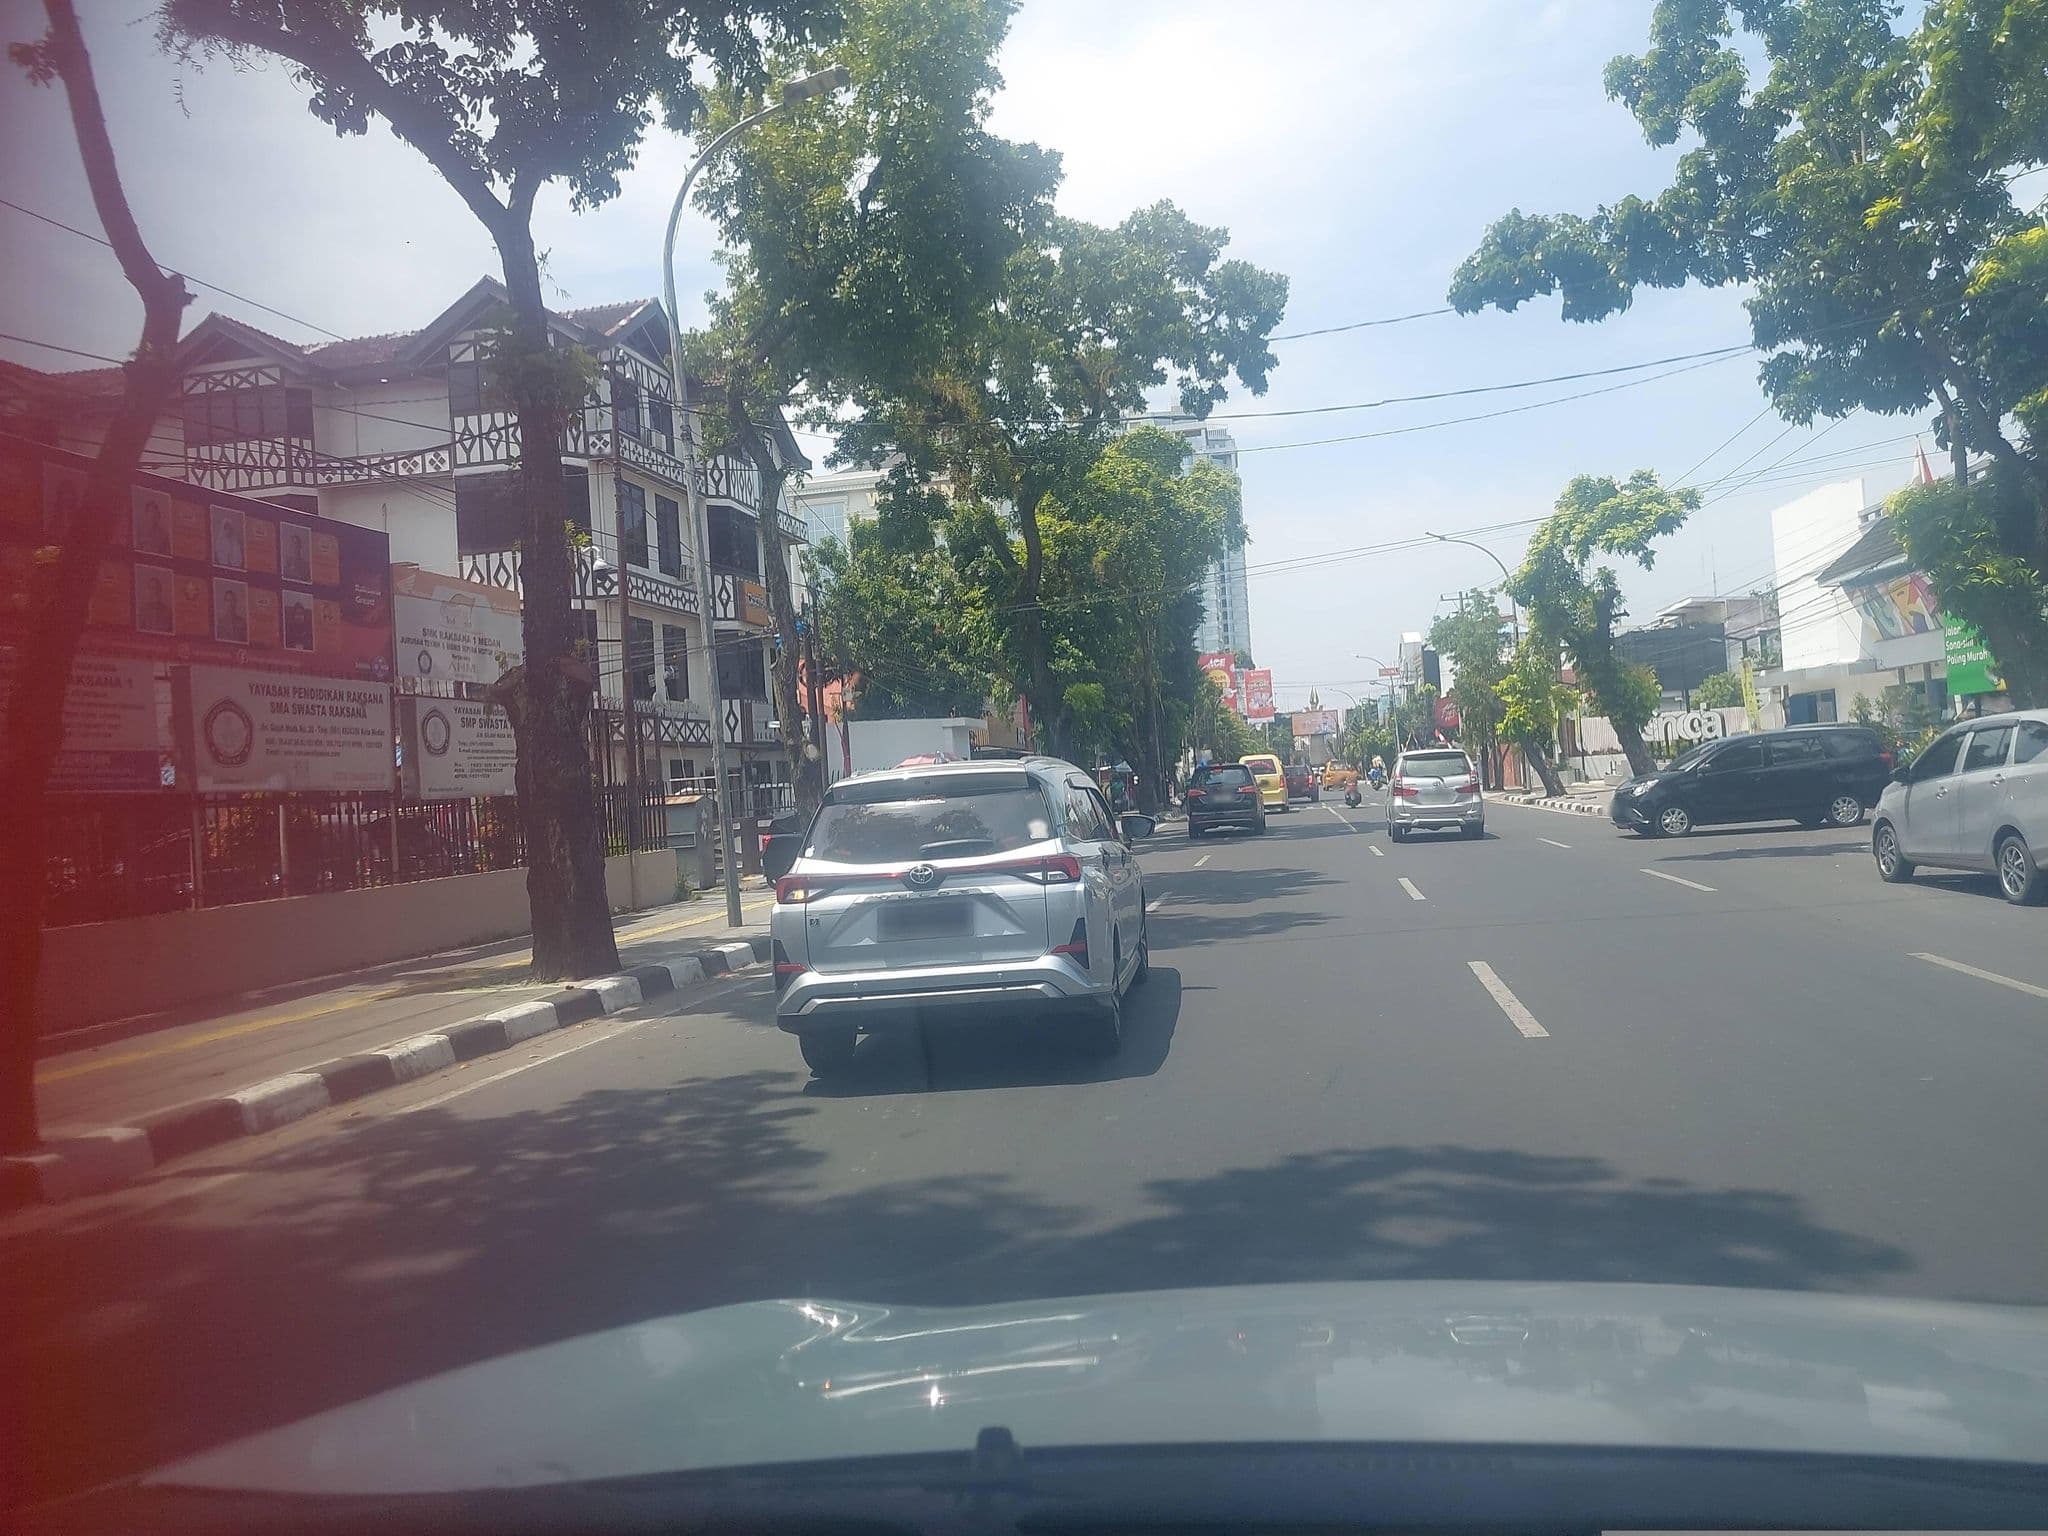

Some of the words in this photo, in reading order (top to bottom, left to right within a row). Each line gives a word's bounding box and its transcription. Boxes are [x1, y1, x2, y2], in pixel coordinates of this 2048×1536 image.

[422, 627, 438, 638] SMK
[1946, 653, 1966, 666] Paling
[1966, 649, 1988, 662] Murah
[248, 683, 291, 699] YAYASAN
[292, 686, 345, 703] PENDIDIKAN
[346, 690, 385, 705] RAKSANA
[269, 701, 290, 714] SMA
[291, 703, 327, 717] SWASTA
[328, 705, 368, 720] RAKSANA
[460, 716, 477, 729] SMP
[478, 717, 508, 730] SWASTA
